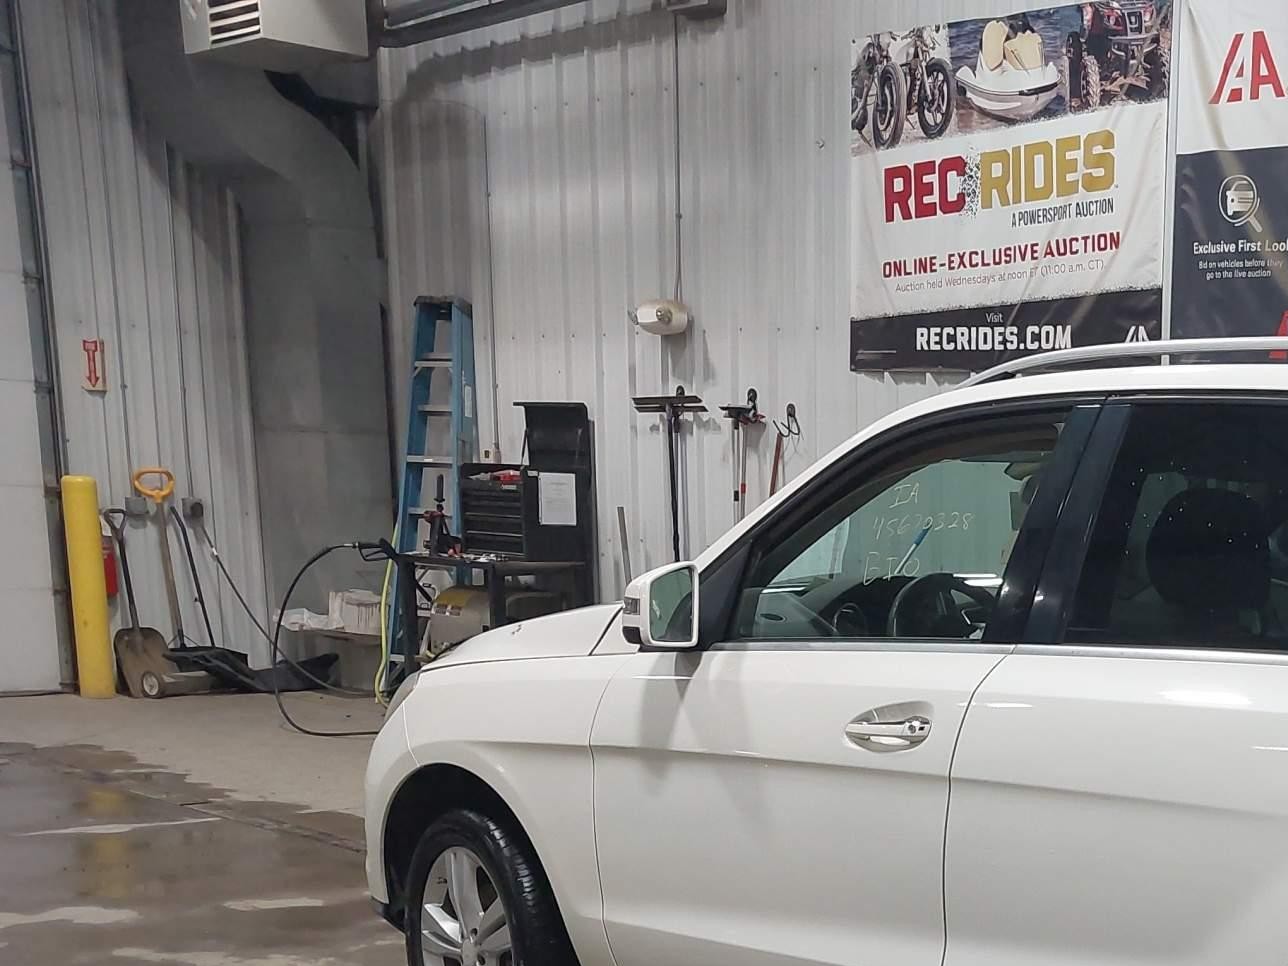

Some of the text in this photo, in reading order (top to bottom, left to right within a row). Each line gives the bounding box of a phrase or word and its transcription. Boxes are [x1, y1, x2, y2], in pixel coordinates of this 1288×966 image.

[883, 129, 1115, 223] REC RIDES
[1011, 197, 1114, 228] A POWERSPORT AUCTION
[883, 231, 1120, 278] ONLINE-EXCLUSIVE AUCTION
[1193, 240, 1236, 254] Exclusive
[1238, 239, 1261, 252] First
[895, 281, 924, 292] Auction
[926, 280, 943, 289] held
[945, 274, 996, 287] Wednesdays
[1007, 271, 1027, 280] noon
[1068, 263, 1085, 273] a.m.
[1088, 259, 1104, 271] CT)
[1206, 268, 1271, 280] go to the live auction
[1208, 261, 1216, 269] on
[1217, 258, 1244, 268] vehicles
[1244, 258, 1265, 267] before
[985, 312, 1004, 323] Visit
[916, 324, 1072, 350] RECRIDES.COM
